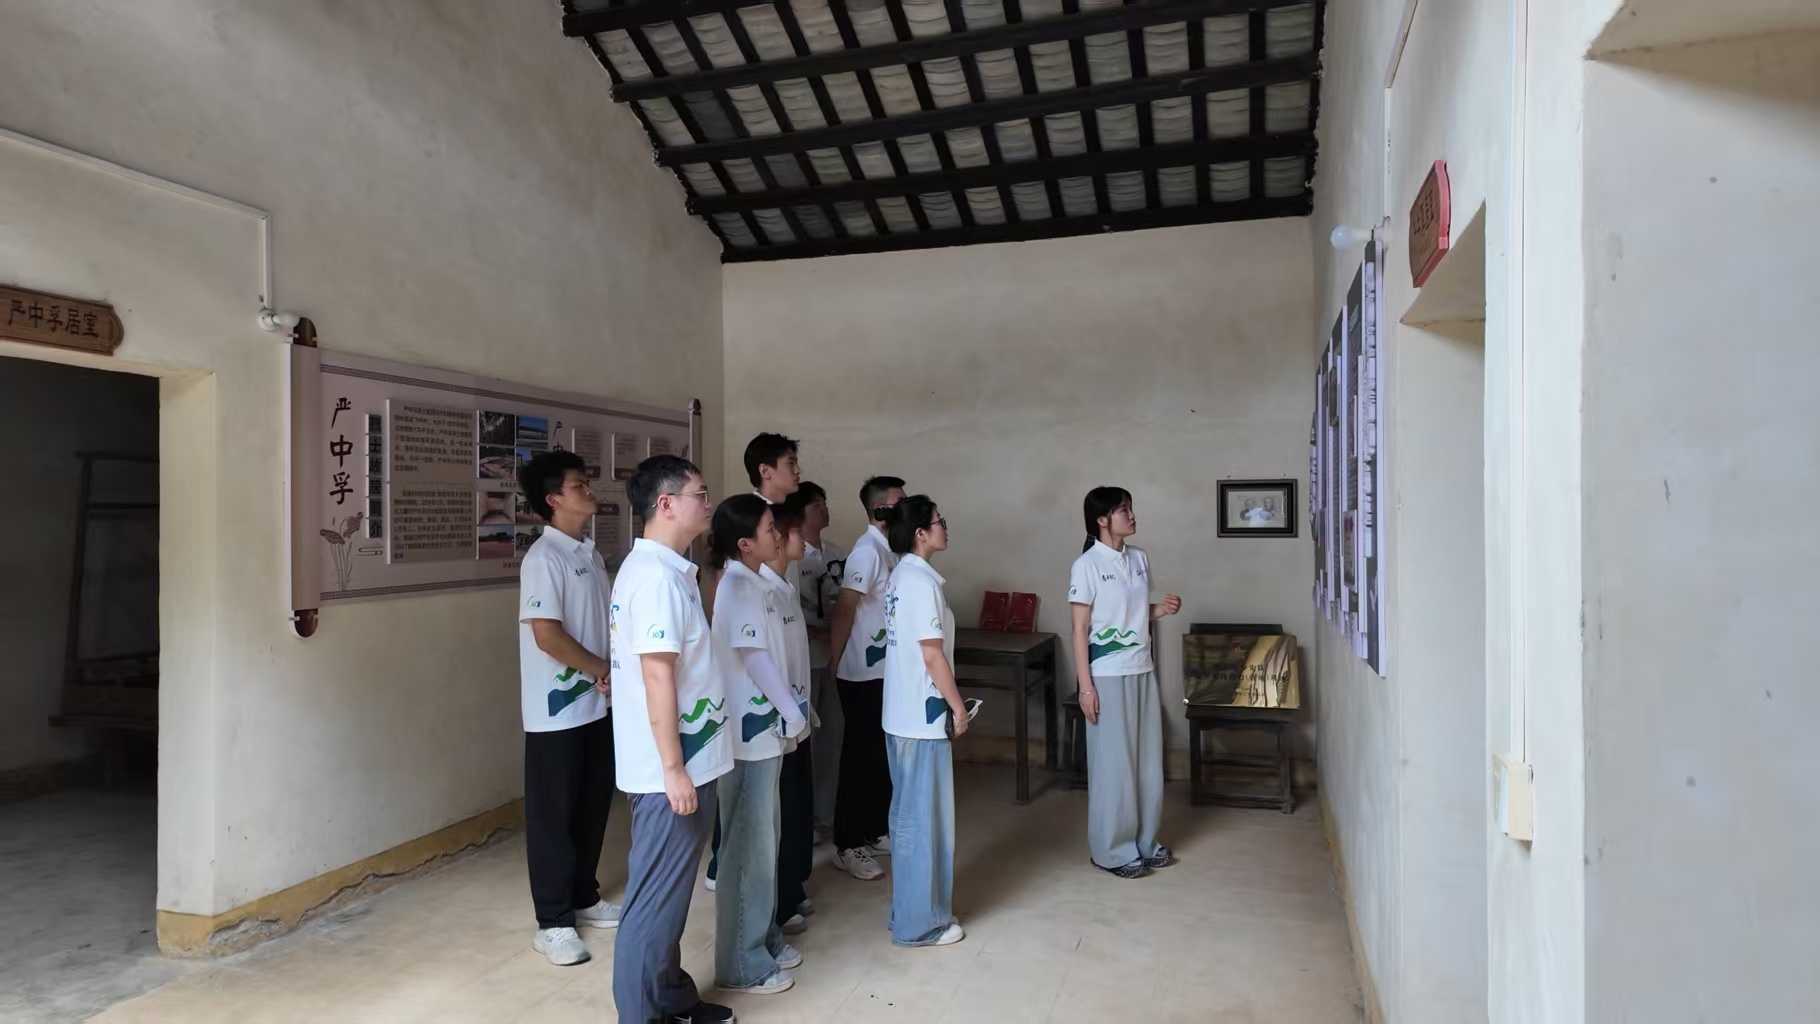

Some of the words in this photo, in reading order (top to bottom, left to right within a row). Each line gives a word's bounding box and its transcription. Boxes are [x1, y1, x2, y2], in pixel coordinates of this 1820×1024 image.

[8, 299, 98, 338] 严中孚居室
[329, 397, 354, 505] 严中孚
